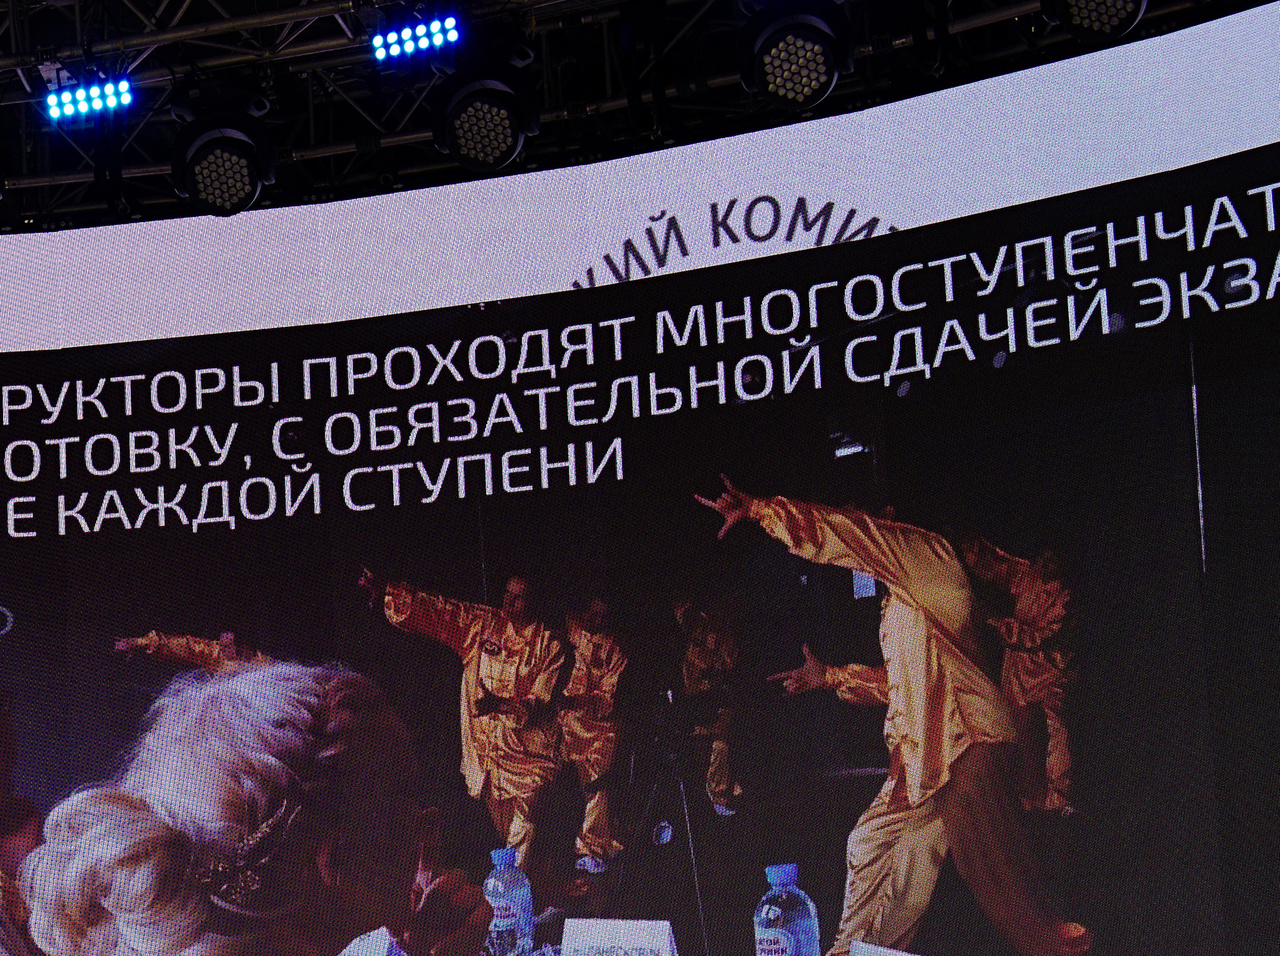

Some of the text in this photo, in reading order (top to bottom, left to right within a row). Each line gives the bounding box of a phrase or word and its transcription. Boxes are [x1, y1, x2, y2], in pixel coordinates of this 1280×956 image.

[572, 195, 900, 289] ИЙ КОМИ
[272, 416, 304, 460] С
[324, 335, 822, 456] ОБЯЗАТЕЛЬНОЙ
[844, 278, 1110, 387] СДАЧЕЙ
[303, 316, 635, 400] ПРОХОДЯТ
[58, 463, 321, 536] КАЖДОЙ
[342, 437, 623, 511] СТУПЕНИ
